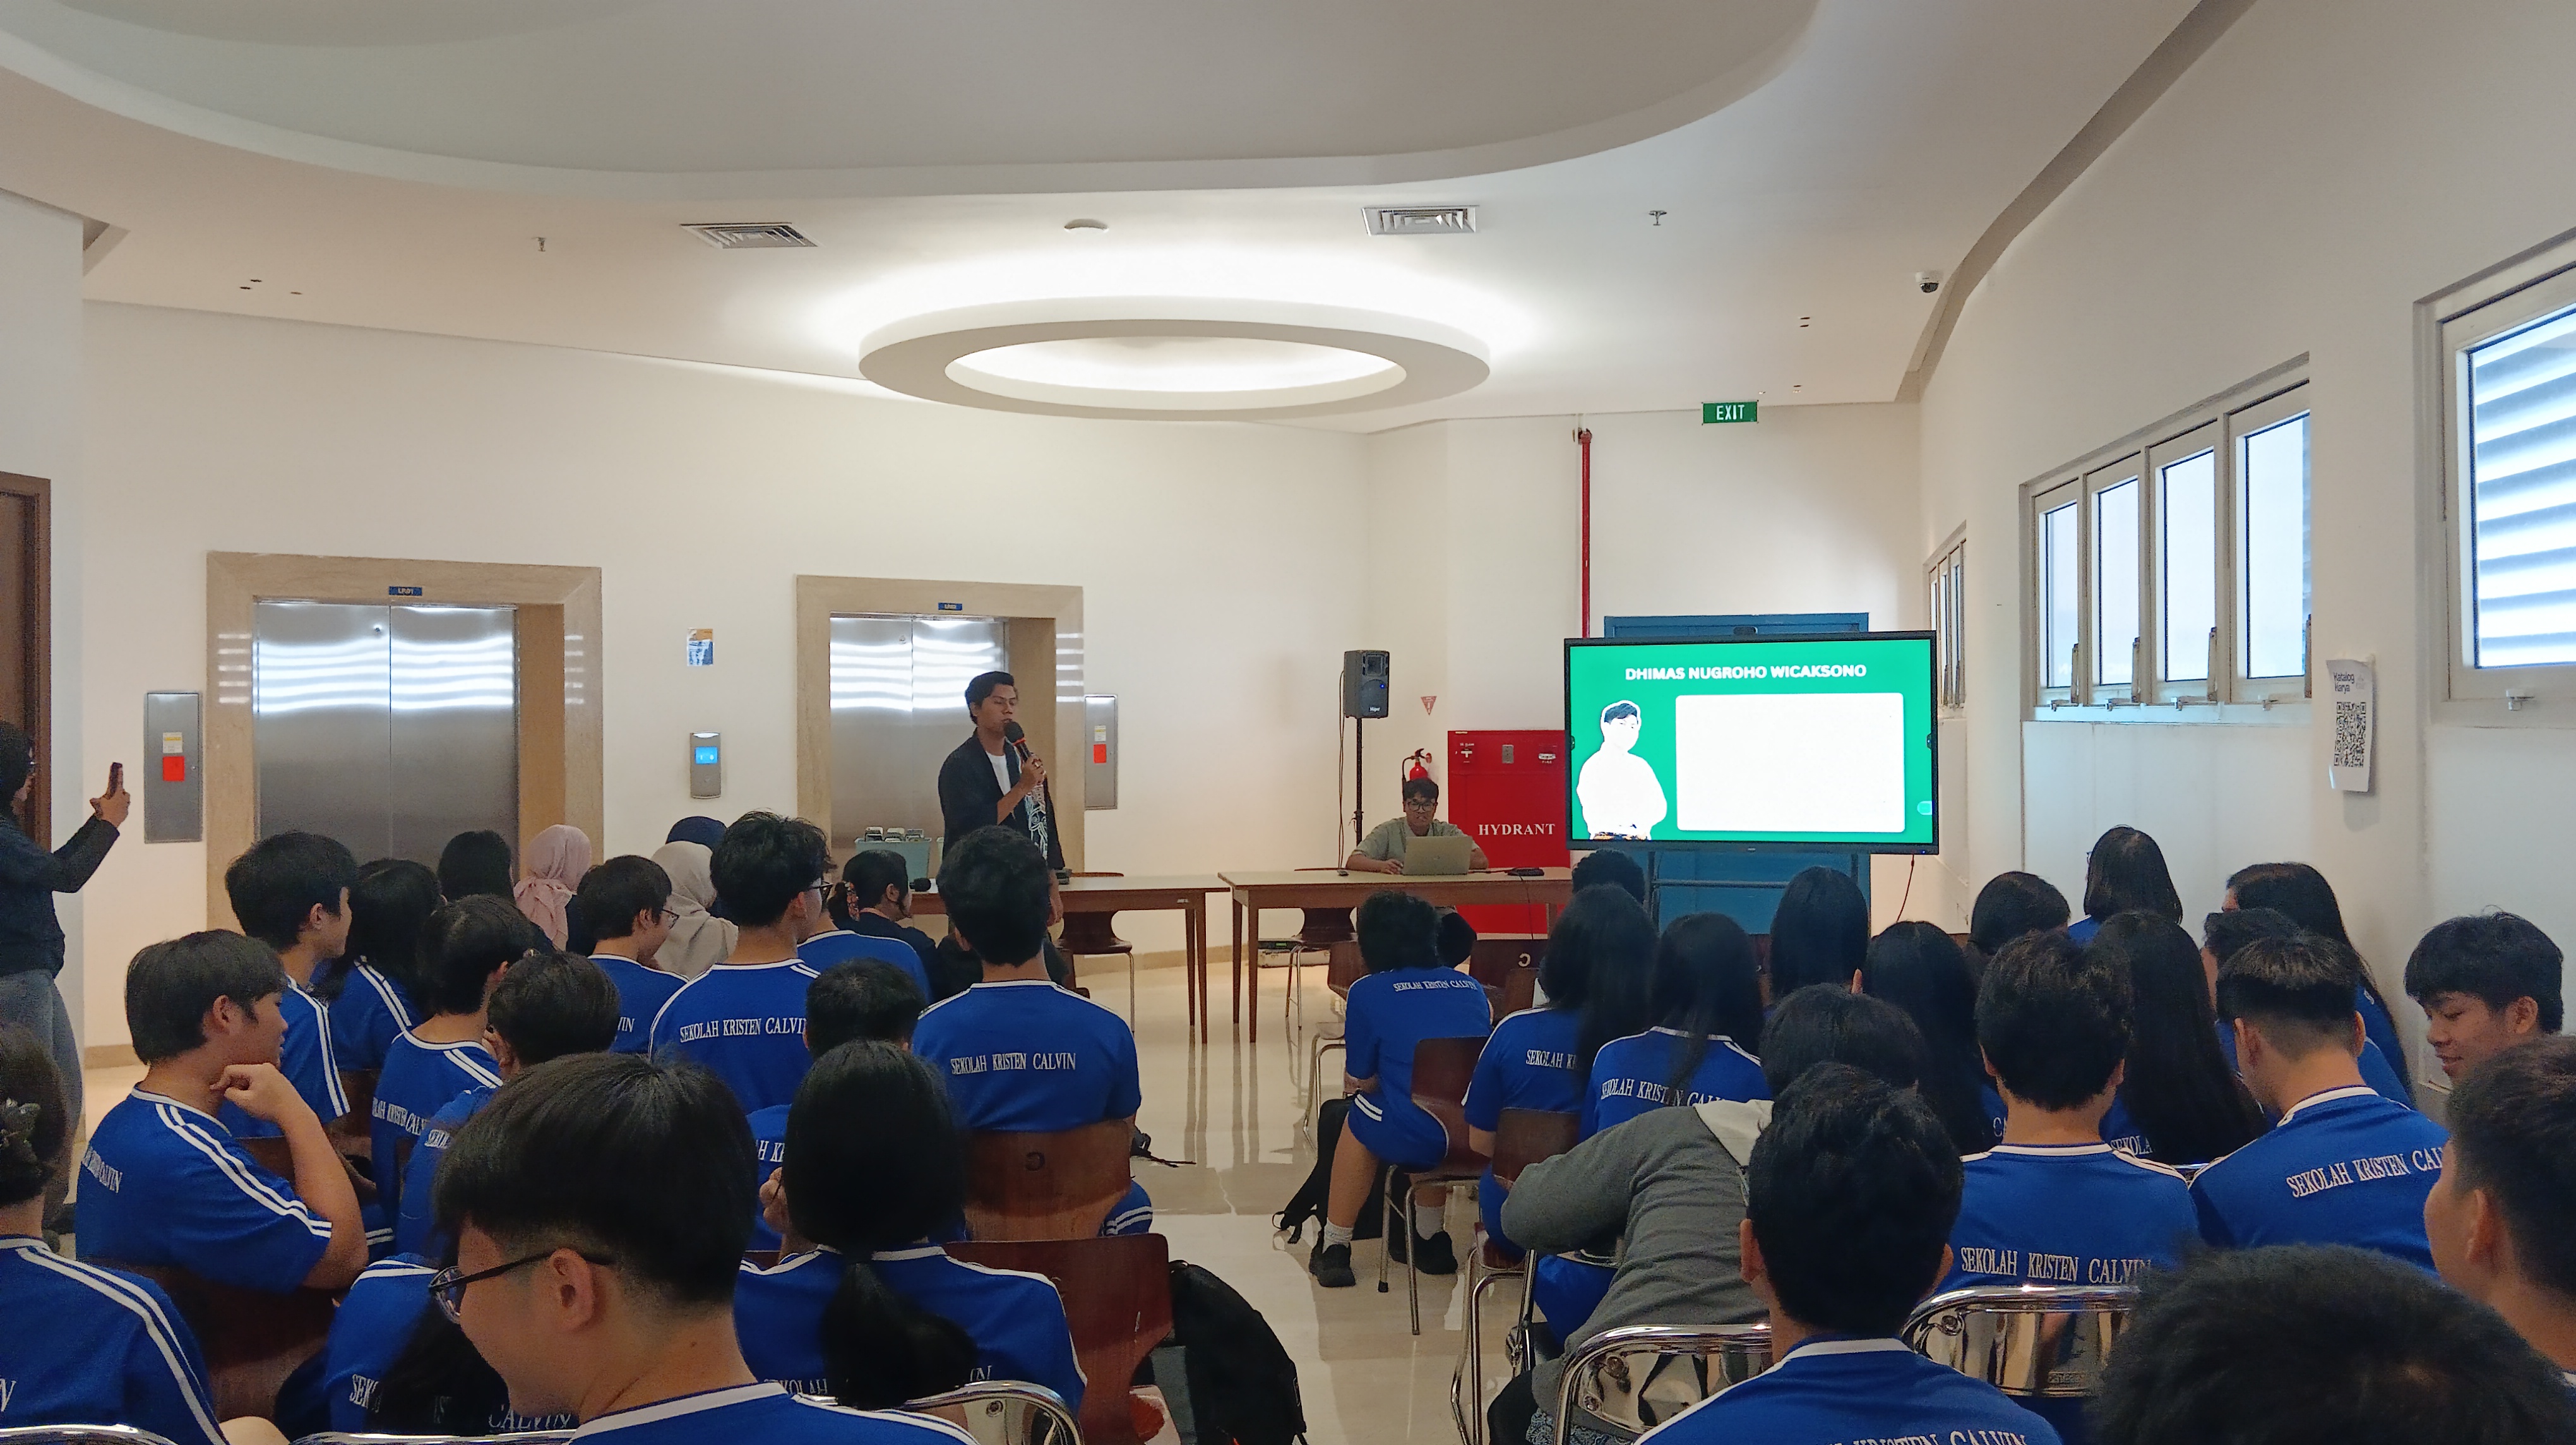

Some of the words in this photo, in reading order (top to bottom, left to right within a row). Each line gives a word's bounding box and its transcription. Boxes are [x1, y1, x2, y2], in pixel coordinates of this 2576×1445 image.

[1717, 404, 1745, 421] EXIT
[1625, 667, 1685, 680] DHIMAS
[1688, 666, 1767, 680] NUGROHO
[1770, 664, 1867, 679] WICAKSONO
[2334, 671, 2355, 684] Katalog
[2335, 682, 2350, 694] Karya
[1478, 823, 1556, 836] HYDRANT
[1393, 981, 1423, 992] SEKOLAH
[680, 1020, 719, 1043] SEKOLAH
[723, 1017, 761, 1036] KRISTEN
[765, 1017, 808, 1035] CALVI
[950, 1055, 988, 1075] SEKOLAH
[992, 1052, 1027, 1071] KRISTEN
[1032, 1052, 1076, 1070] CALVIN
[1525, 1049, 1564, 1069] SEKOLAH
[1637, 1081, 1685, 1106] KRISTN
[2286, 1162, 2354, 1198] SEKOLAH
[2352, 1153, 2411, 1182] KRISTEN
[1960, 1247, 2018, 1276] SEKOLAH
[2027, 1252, 2080, 1283] KRISTEN
